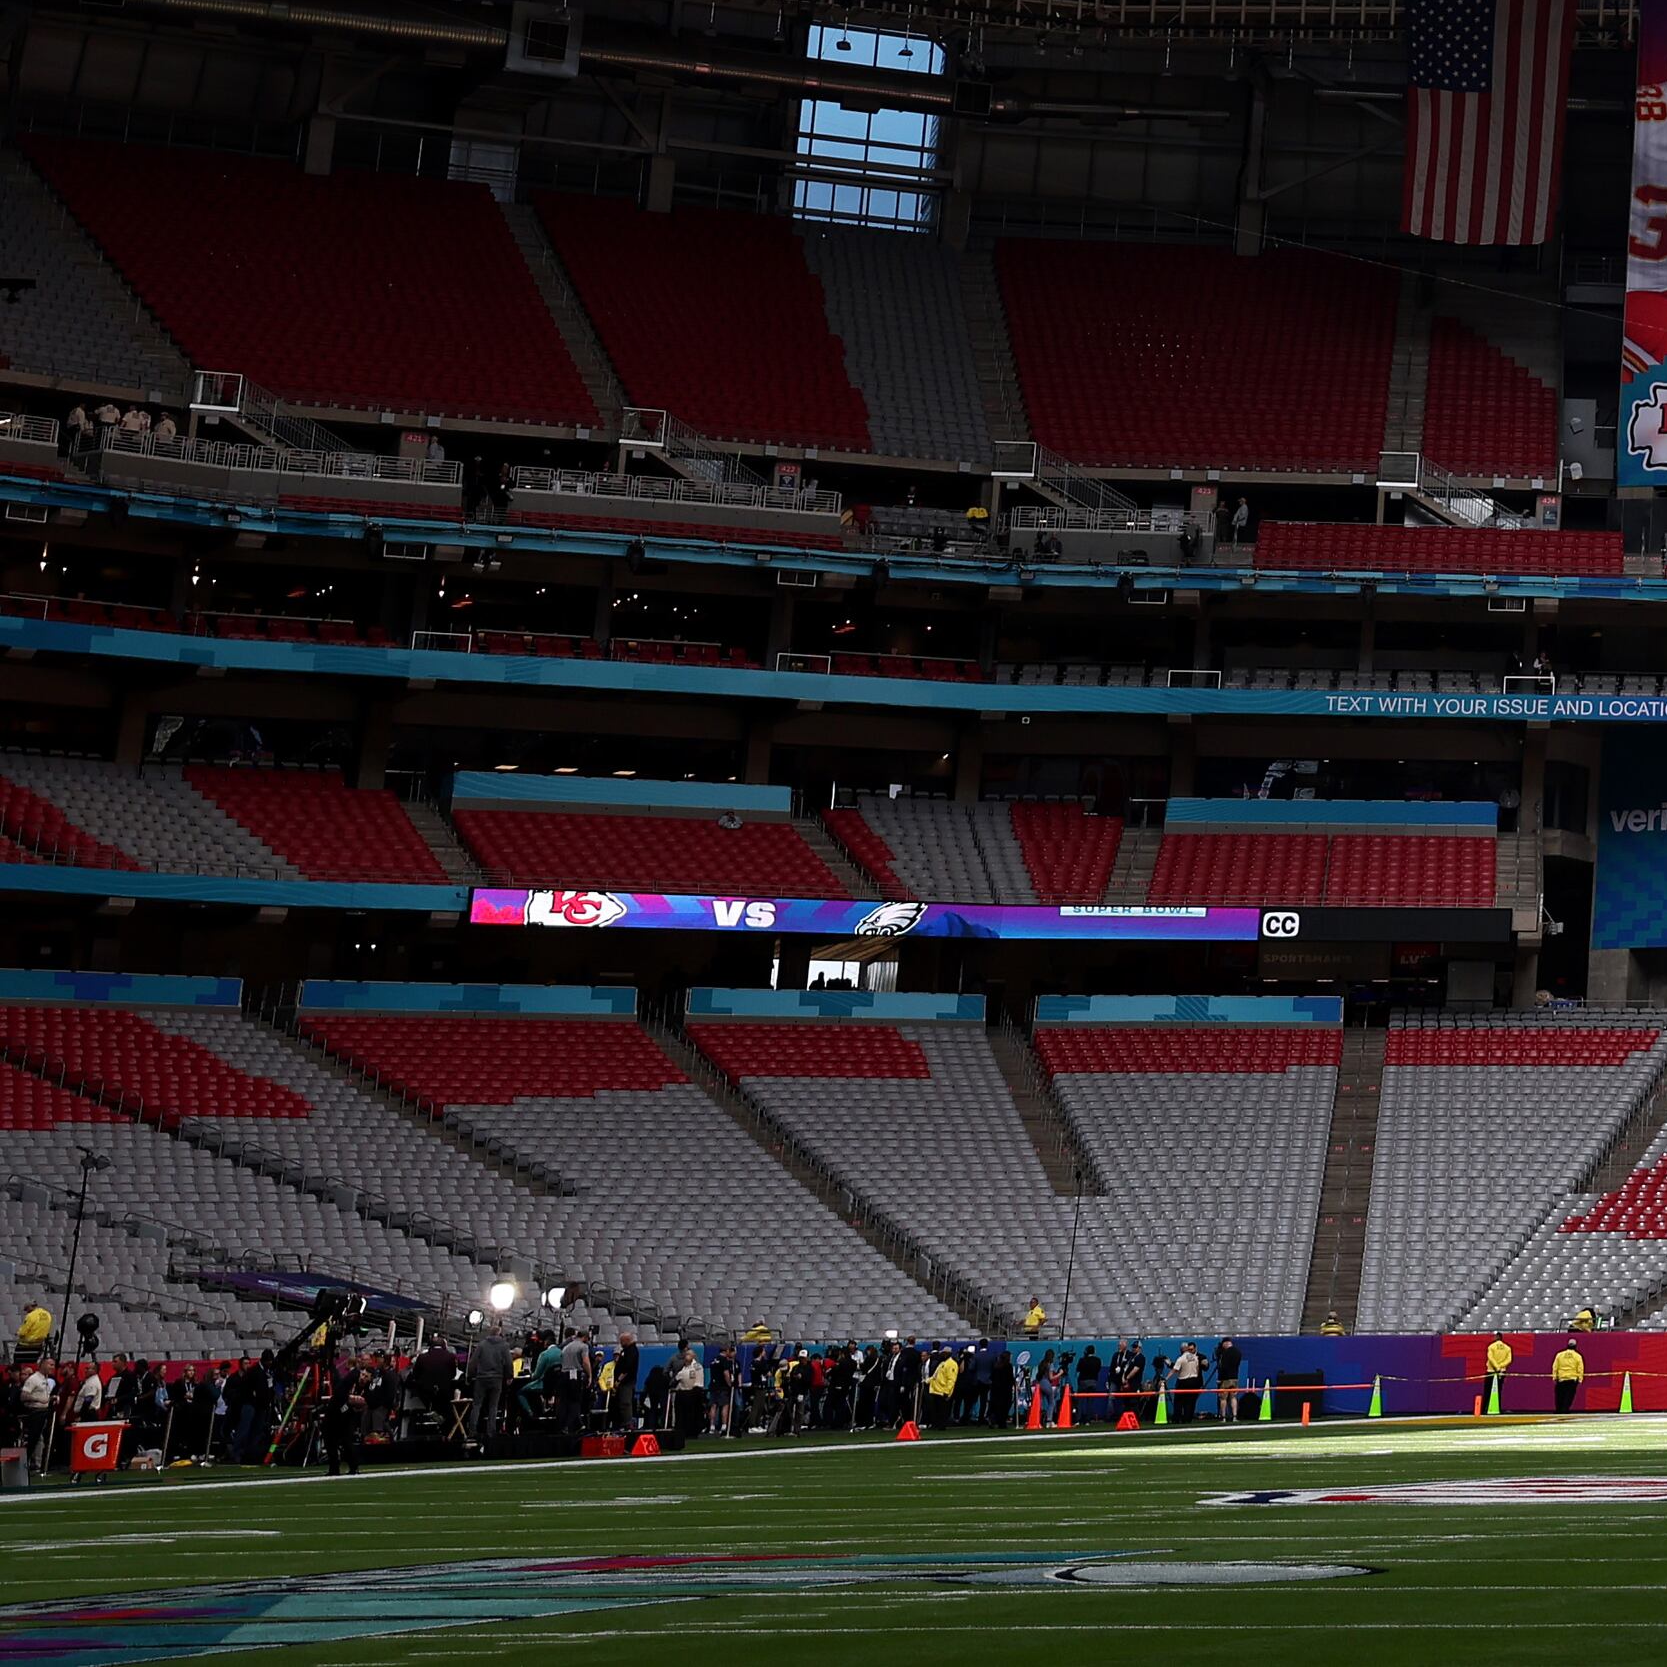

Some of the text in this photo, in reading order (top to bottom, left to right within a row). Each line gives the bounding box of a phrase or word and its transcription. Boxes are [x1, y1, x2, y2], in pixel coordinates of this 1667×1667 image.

[1326, 696, 1373, 713] TEXT
[1379, 697, 1430, 714] WITH
[1433, 698, 1488, 716] YOUR
[1493, 699, 1549, 716] ISSUE
[1554, 700, 1593, 717] AND
[712, 901, 776, 927] VS
[1266, 916, 1296, 934] CC
[83, 1433, 108, 1458] G
